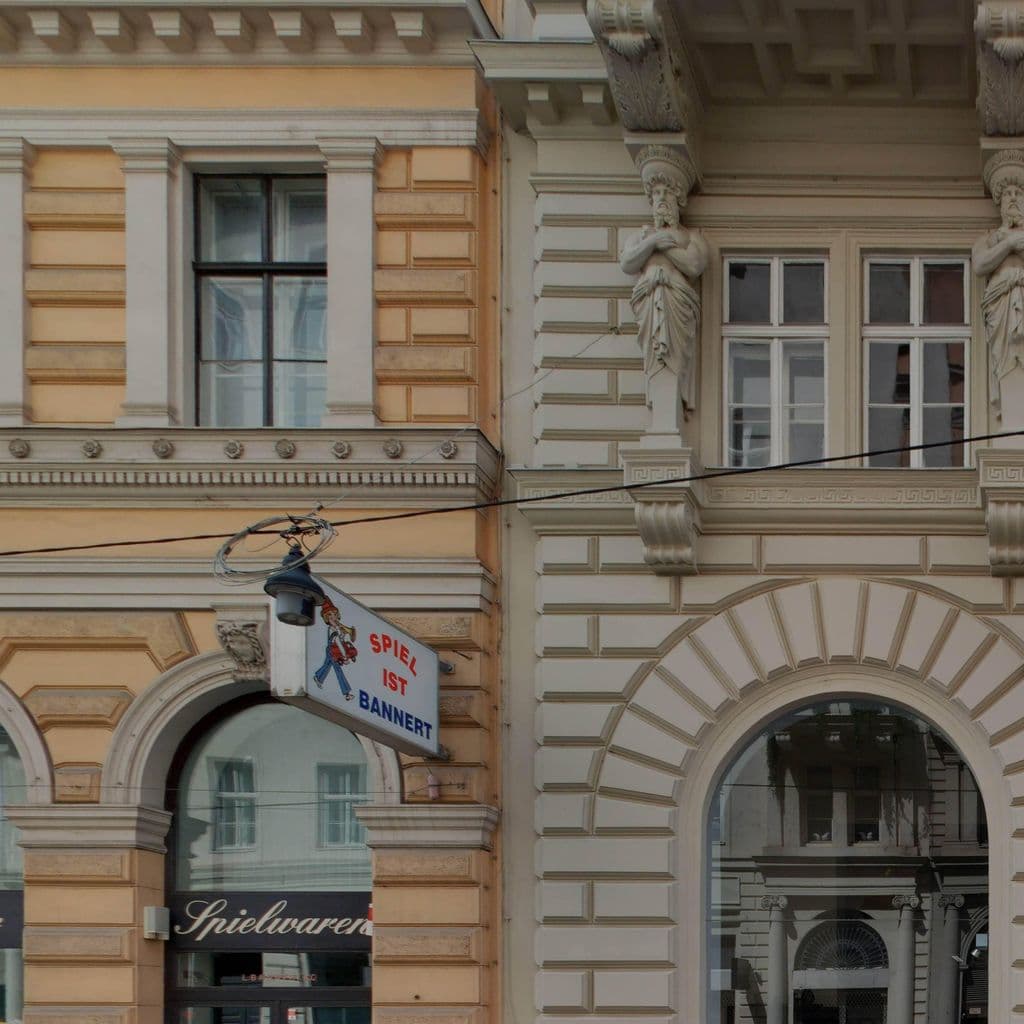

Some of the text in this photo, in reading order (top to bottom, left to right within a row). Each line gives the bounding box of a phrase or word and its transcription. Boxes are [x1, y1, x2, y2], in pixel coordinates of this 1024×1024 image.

[369, 632, 418, 678] SPIEL
[383, 667, 408, 697] IST
[358, 689, 433, 740] BANNERT
[174, 898, 371, 942] Spielwaren
